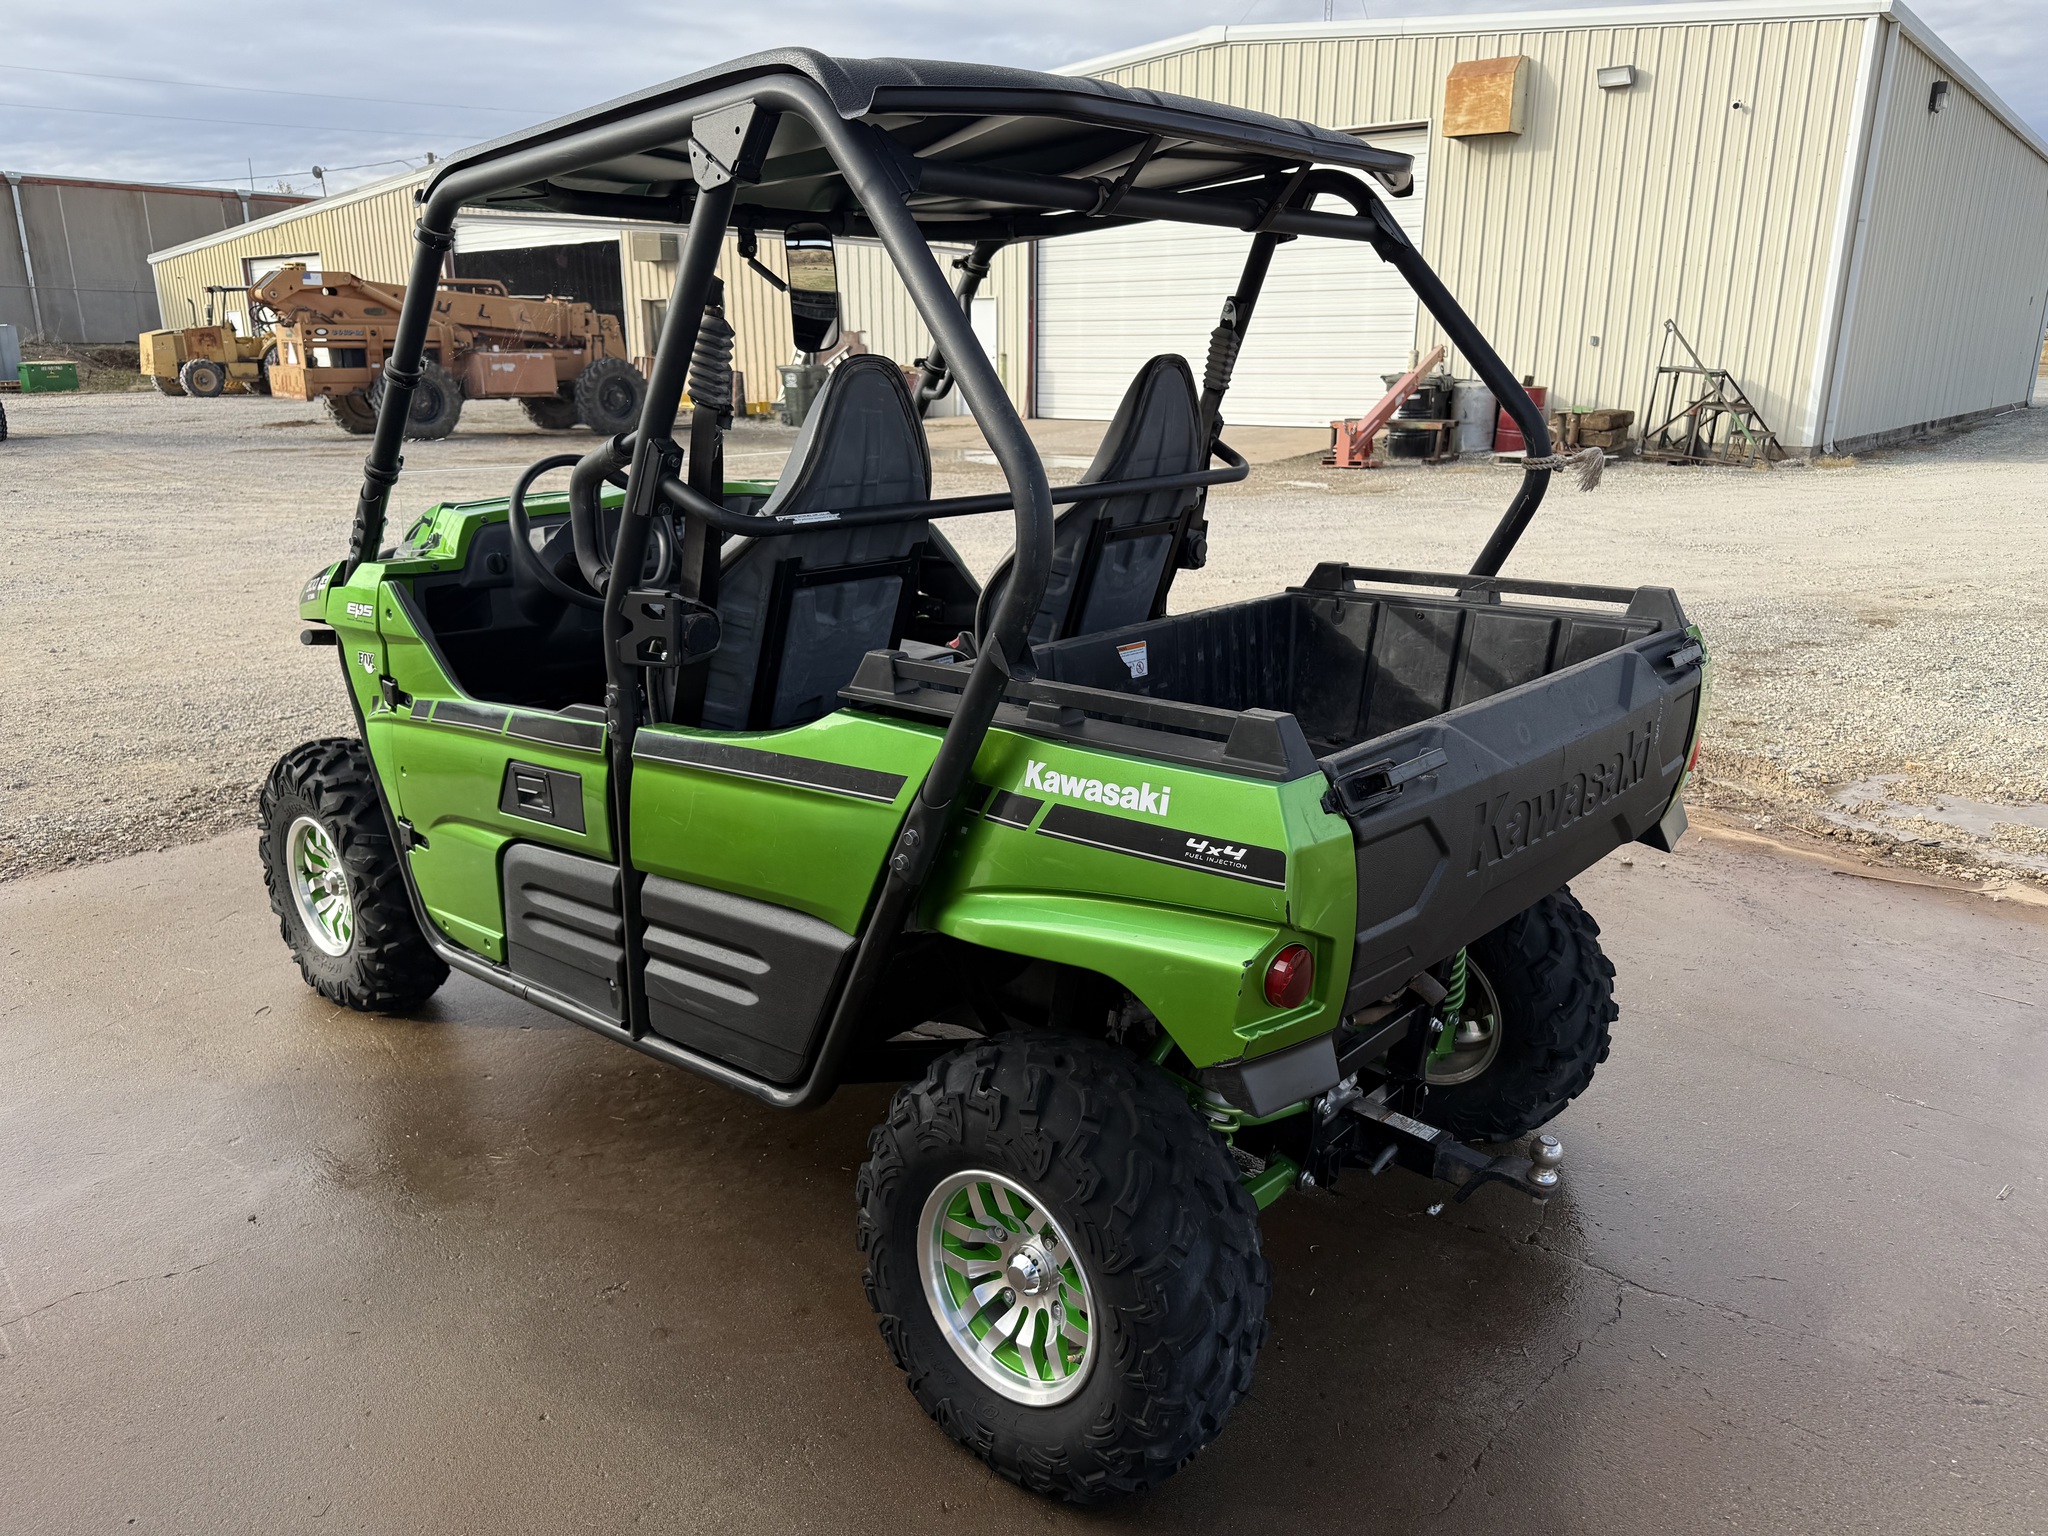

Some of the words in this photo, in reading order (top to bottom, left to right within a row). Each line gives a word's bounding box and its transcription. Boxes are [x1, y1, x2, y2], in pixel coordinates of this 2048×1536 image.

[1023, 759, 1172, 817] Kawasaki
[1467, 721, 1652, 877] Kawasaki
[1184, 851, 1204, 861] FUEL
[1206, 856, 1248, 870] INJECTION
[1185, 837, 1248, 861] 4x4
